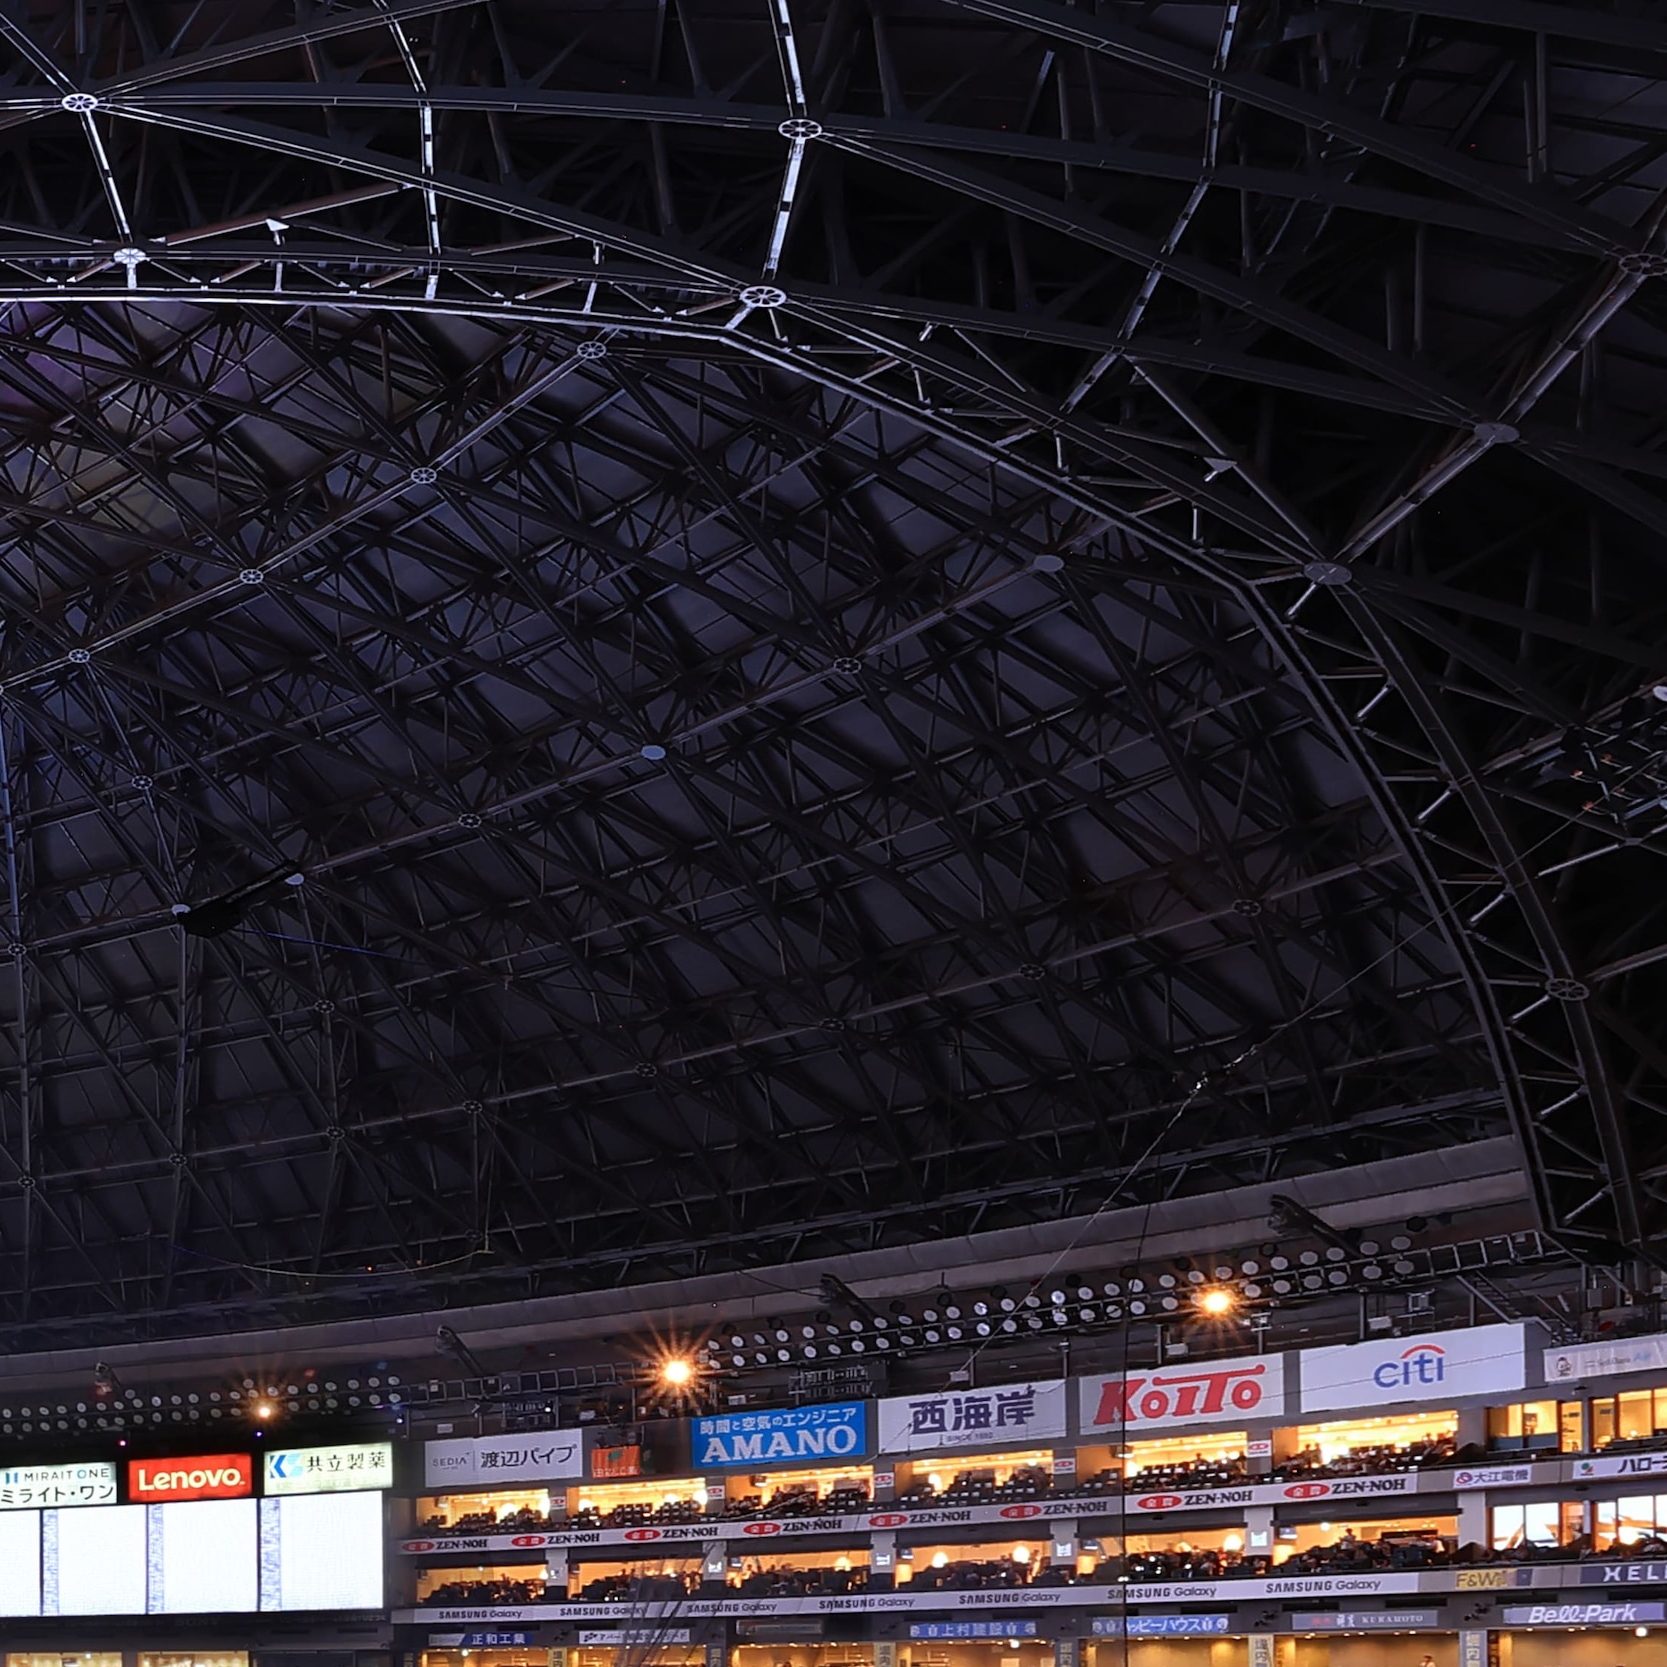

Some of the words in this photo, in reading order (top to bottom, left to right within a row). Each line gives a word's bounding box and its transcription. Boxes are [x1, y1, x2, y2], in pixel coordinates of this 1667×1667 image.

[1374, 1350, 1444, 1388] citi
[909, 1386, 1035, 1434] 西海岸
[700, 1408, 856, 1435] 時間と空気のエンジニア
[702, 1424, 857, 1463] AMANO
[307, 1450, 386, 1474] 共立製薬
[480, 1447, 574, 1468] 渡辺パイプ
[23, 1470, 75, 1483] MIRAIT
[78, 1467, 110, 1479] ONE
[138, 1466, 240, 1491] Lenovo
[1, 1483, 114, 1504] ミライト・ワン
[1331, 1478, 1406, 1494] ZEN-NOH
[1184, 1490, 1253, 1506] ZEN-NOH
[1043, 1501, 1108, 1515] ZEN-NOH
[909, 1511, 971, 1524] ZEN-NOH
[662, 1526, 719, 1539] ZEN-NOH
[783, 1519, 842, 1533] ZEN-NOH
[436, 1538, 488, 1550] ZEN-NOH
[547, 1532, 600, 1545] ZEN-NOH
[1107, 1587, 1171, 1600] SAMSUNG
[1174, 1585, 1217, 1599] Galaxy
[1266, 1580, 1333, 1594] SAMSUNG
[1336, 1577, 1381, 1592] Galaxy
[819, 1598, 875, 1610] SAMSUNG
[878, 1598, 915, 1609] Galaxy
[959, 1593, 1017, 1605] SAMSUNG
[1021, 1591, 1061, 1603] Galaxy
[439, 1610, 487, 1619] SAMSUNG
[489, 1609, 522, 1619] Galaxy
[560, 1607, 609, 1616] SAMSUNG
[687, 1603, 739, 1613] SAMSUNG
[741, 1602, 777, 1614] Galaxy
[1529, 1604, 1637, 1623] Bell-Park
